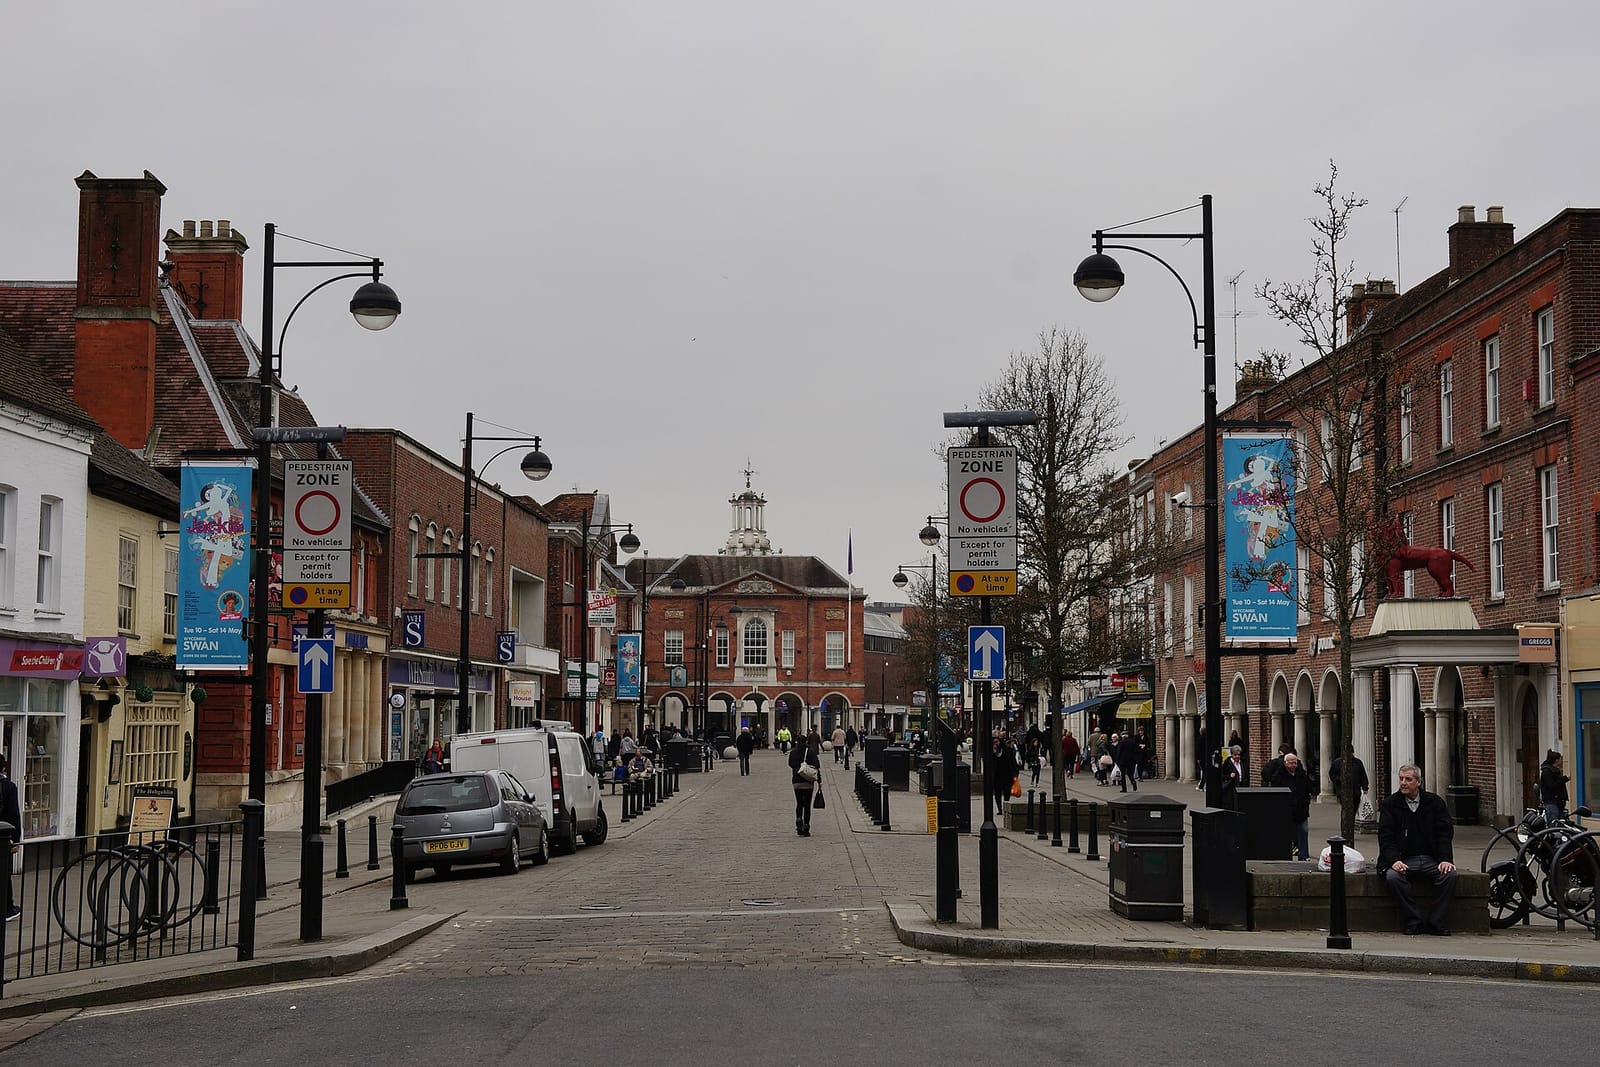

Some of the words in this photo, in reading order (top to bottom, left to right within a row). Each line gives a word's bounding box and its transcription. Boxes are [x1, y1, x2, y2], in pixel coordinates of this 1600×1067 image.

[952, 450, 1013, 458] PEDESTRIAN
[288, 463, 349, 471] PEDESTRIAN
[961, 461, 1003, 473] ZONE
[296, 474, 340, 485] ZONE
[973, 525, 1008, 533] vehicles
[292, 538, 305, 546] No
[308, 538, 343, 546] vehicles
[960, 541, 990, 549] Except
[294, 553, 325, 562] Except
[327, 553, 340, 561] for
[968, 550, 998, 558] permit
[302, 563, 331, 571] permit
[967, 559, 999, 567] holders
[301, 571, 333, 579] holders
[315, 587, 325, 595] At
[986, 584, 1005, 592] time
[1232, 613, 1268, 623] SWAN
[228, 627, 242, 635] May
[406, 622, 421, 646] S
[183, 641, 219, 651] SWAN
[500, 642, 513, 661] S
[430, 841, 449, 851] RF06
[449, 840, 465, 848] GJV
